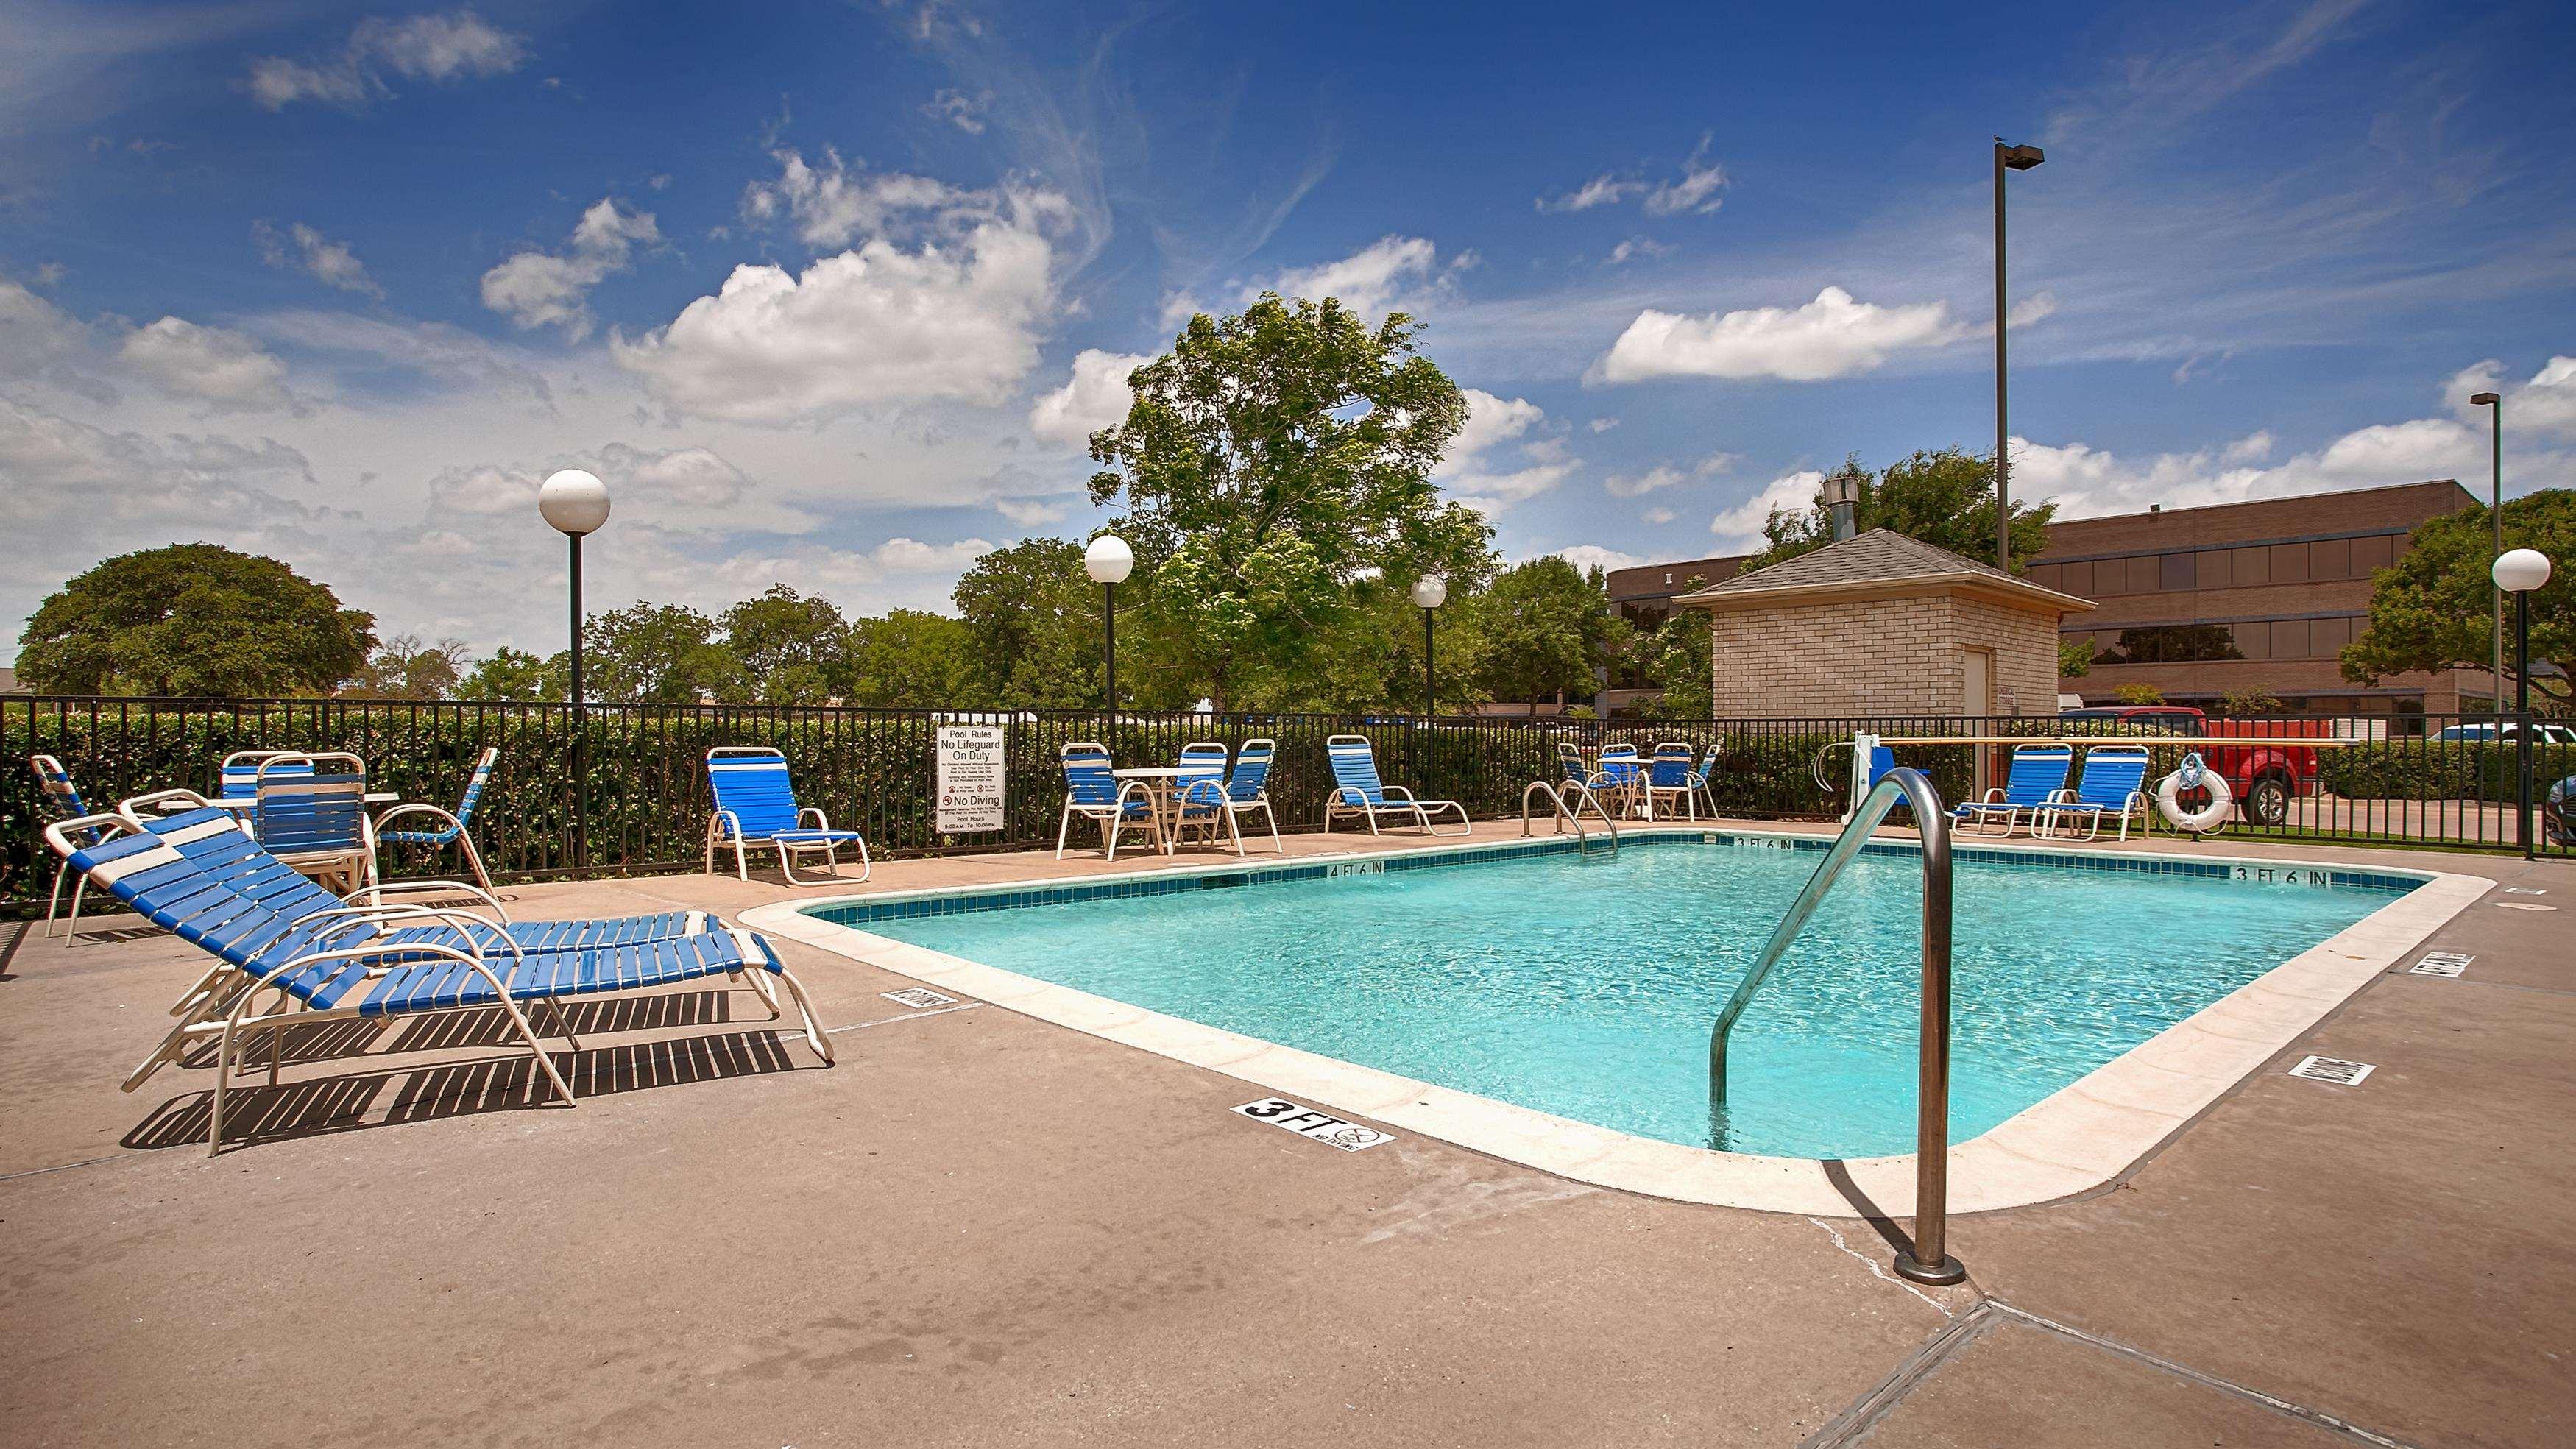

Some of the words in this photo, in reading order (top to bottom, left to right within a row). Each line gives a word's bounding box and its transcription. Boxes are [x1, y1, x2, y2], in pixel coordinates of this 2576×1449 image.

[949, 730, 966, 738] Pool
[972, 730, 992, 738] Rules
[941, 740, 955, 749] No
[958, 740, 1000, 751] Lifeguard
[952, 751, 966, 760] On
[969, 751, 990, 762] Duty
[954, 796, 968, 806] No
[970, 796, 1000, 807] Diving
[1738, 837, 1744, 846] 3
[1767, 840, 1774, 848] 6
[1780, 840, 1791, 850] IN
[1330, 865, 1338, 876] 4
[1343, 864, 1354, 876] FT
[1359, 864, 1366, 876] 6
[1372, 862, 1382, 874] IN
[2237, 868, 2247, 881] 3
[2258, 868, 2275, 882] FT
[2286, 871, 2297, 883] 6
[2310, 871, 2326, 885] IN
[1245, 1102, 1295, 1117] 3
[1275, 1111, 1348, 1132] FT
[1326, 1138, 1359, 1150] DIVING
